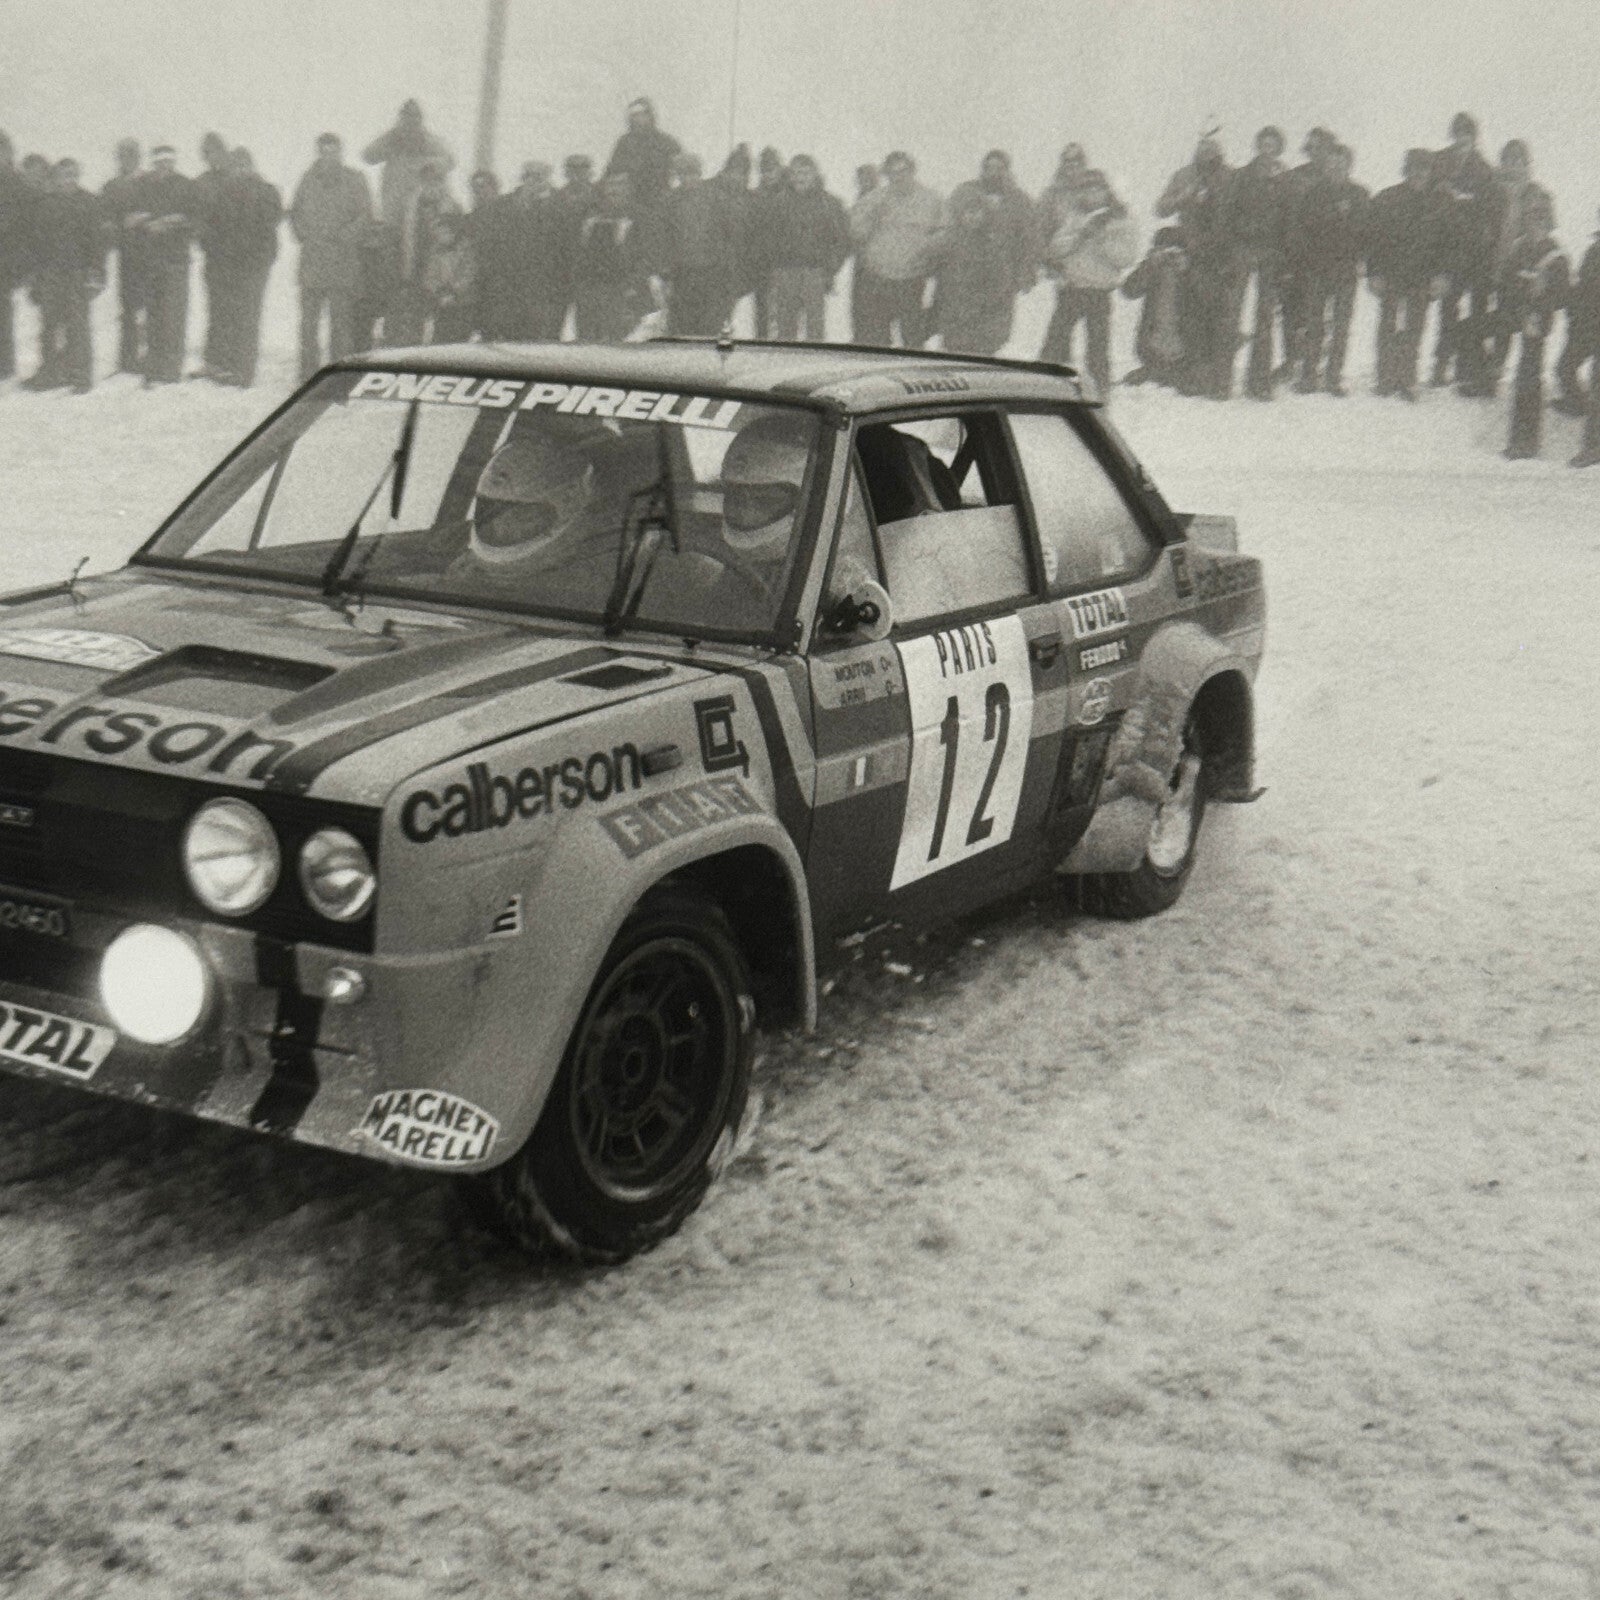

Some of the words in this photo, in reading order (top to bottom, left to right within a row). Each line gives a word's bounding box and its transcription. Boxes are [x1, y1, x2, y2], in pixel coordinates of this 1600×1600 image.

[348, 371, 527, 409] PNEUS
[519, 381, 742, 429] PIRELLI
[1068, 590, 1126, 633] TOTAL
[930, 622, 997, 678] PARIS
[0, 690, 295, 781] erson
[400, 742, 642, 843] calberson
[927, 682, 1011, 863] 12
[614, 783, 750, 847] FIAT
